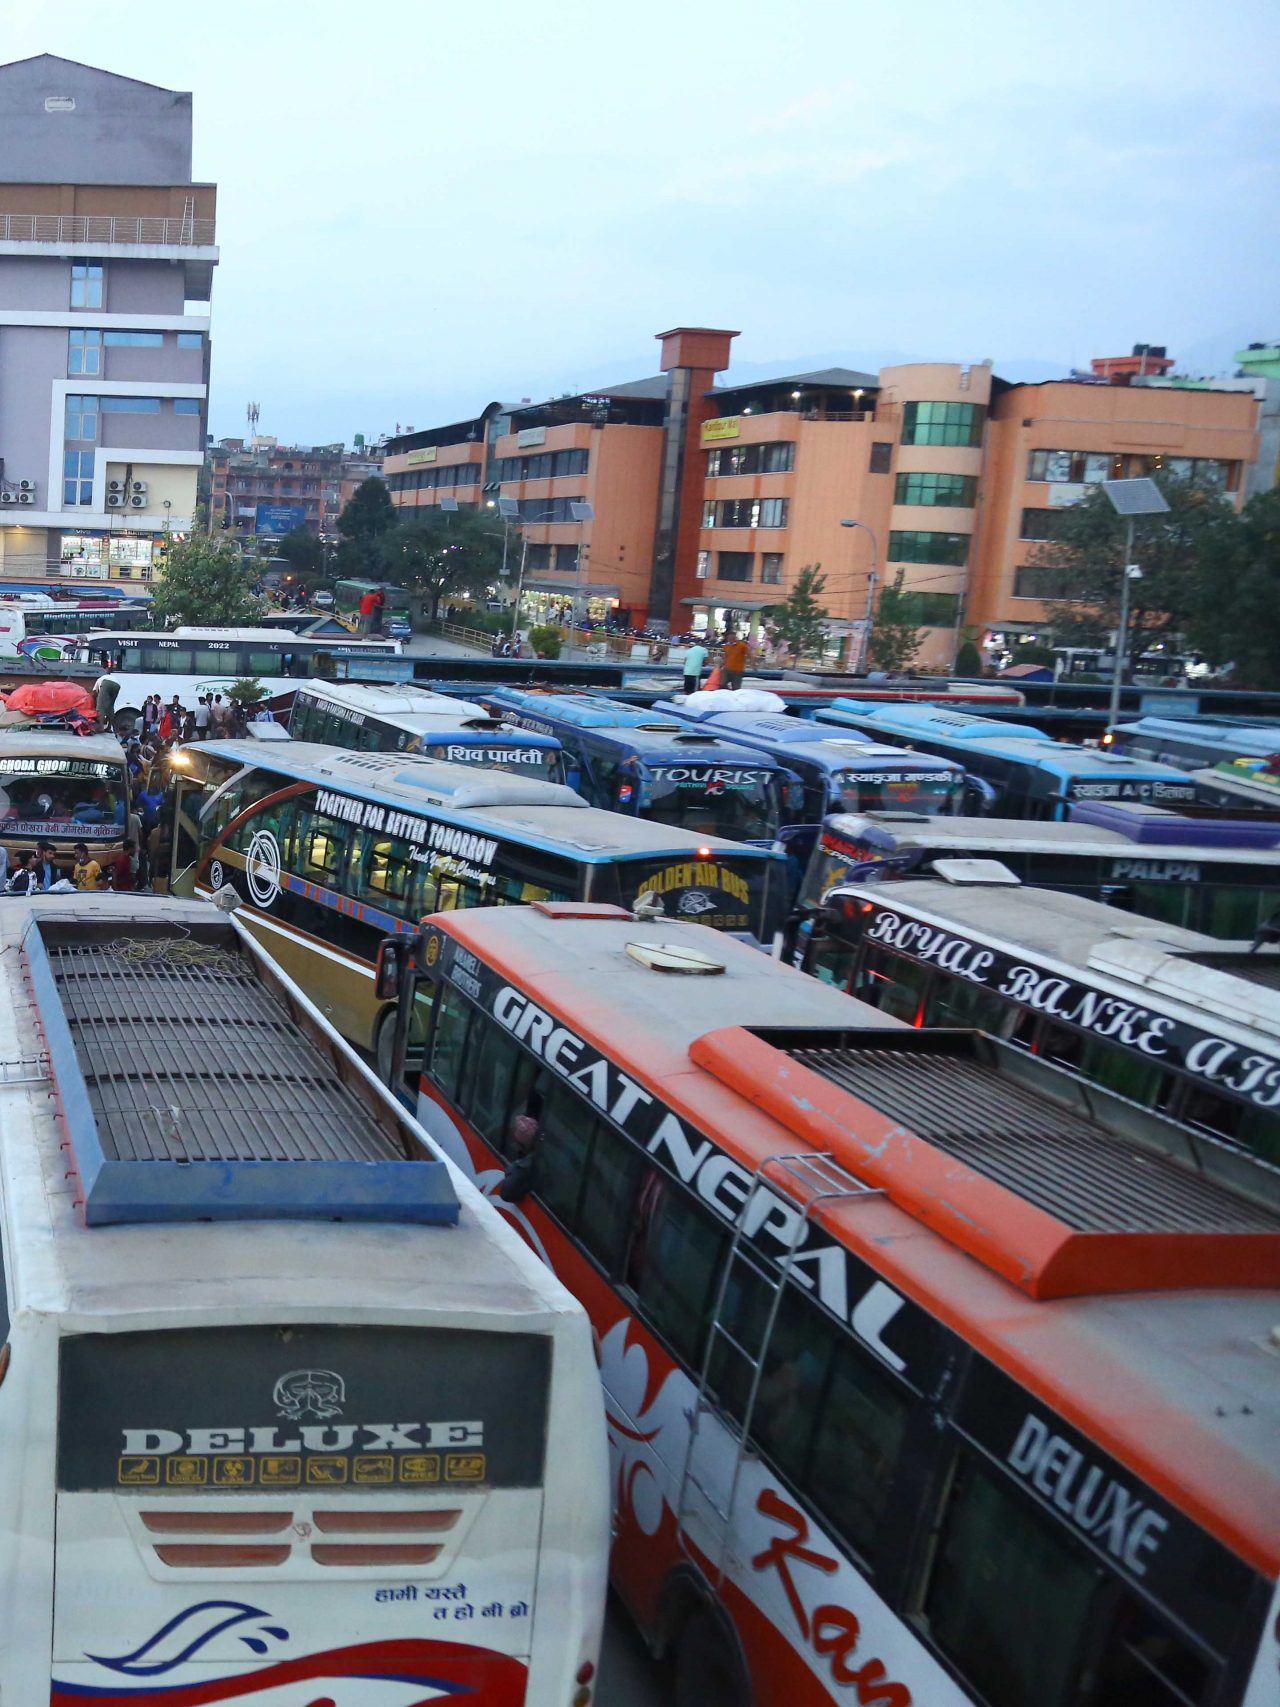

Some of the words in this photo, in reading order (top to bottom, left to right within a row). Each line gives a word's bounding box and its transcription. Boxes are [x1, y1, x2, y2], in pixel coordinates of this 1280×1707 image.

[0, 760, 35, 771] GHODA
[37, 760, 70, 772] GHODI
[72, 762, 109, 775] DELUXE
[447, 745, 480, 762] शिव
[487, 747, 544, 765] पार्वती
[650, 768, 775, 785] TOURIST
[315, 790, 363, 823] TOGETHER
[362, 805, 385, 831] FOR
[385, 812, 427, 842] BETTER
[428, 822, 499, 866] TOMORROW
[638, 863, 693, 897] GOLDEN
[694, 863, 719, 888] AIR
[721, 867, 749, 905] BUS
[1111, 862, 1201, 881] PALPA
[867, 911, 996, 983] ROYAL
[999, 966, 1177, 1056] BANKE
[493, 985, 654, 1126] GREAT
[647, 1112, 908, 1372] NEPAL
[121, 1421, 484, 1456] DELUXE
[1006, 1414, 1170, 1577] DELUXE
[374, 1584, 418, 1603] हामी
[424, 1582, 467, 1601] यस्तै
[433, 1606, 447, 1620] त
[454, 1603, 474, 1620] हो
[481, 1602, 503, 1618] नी
